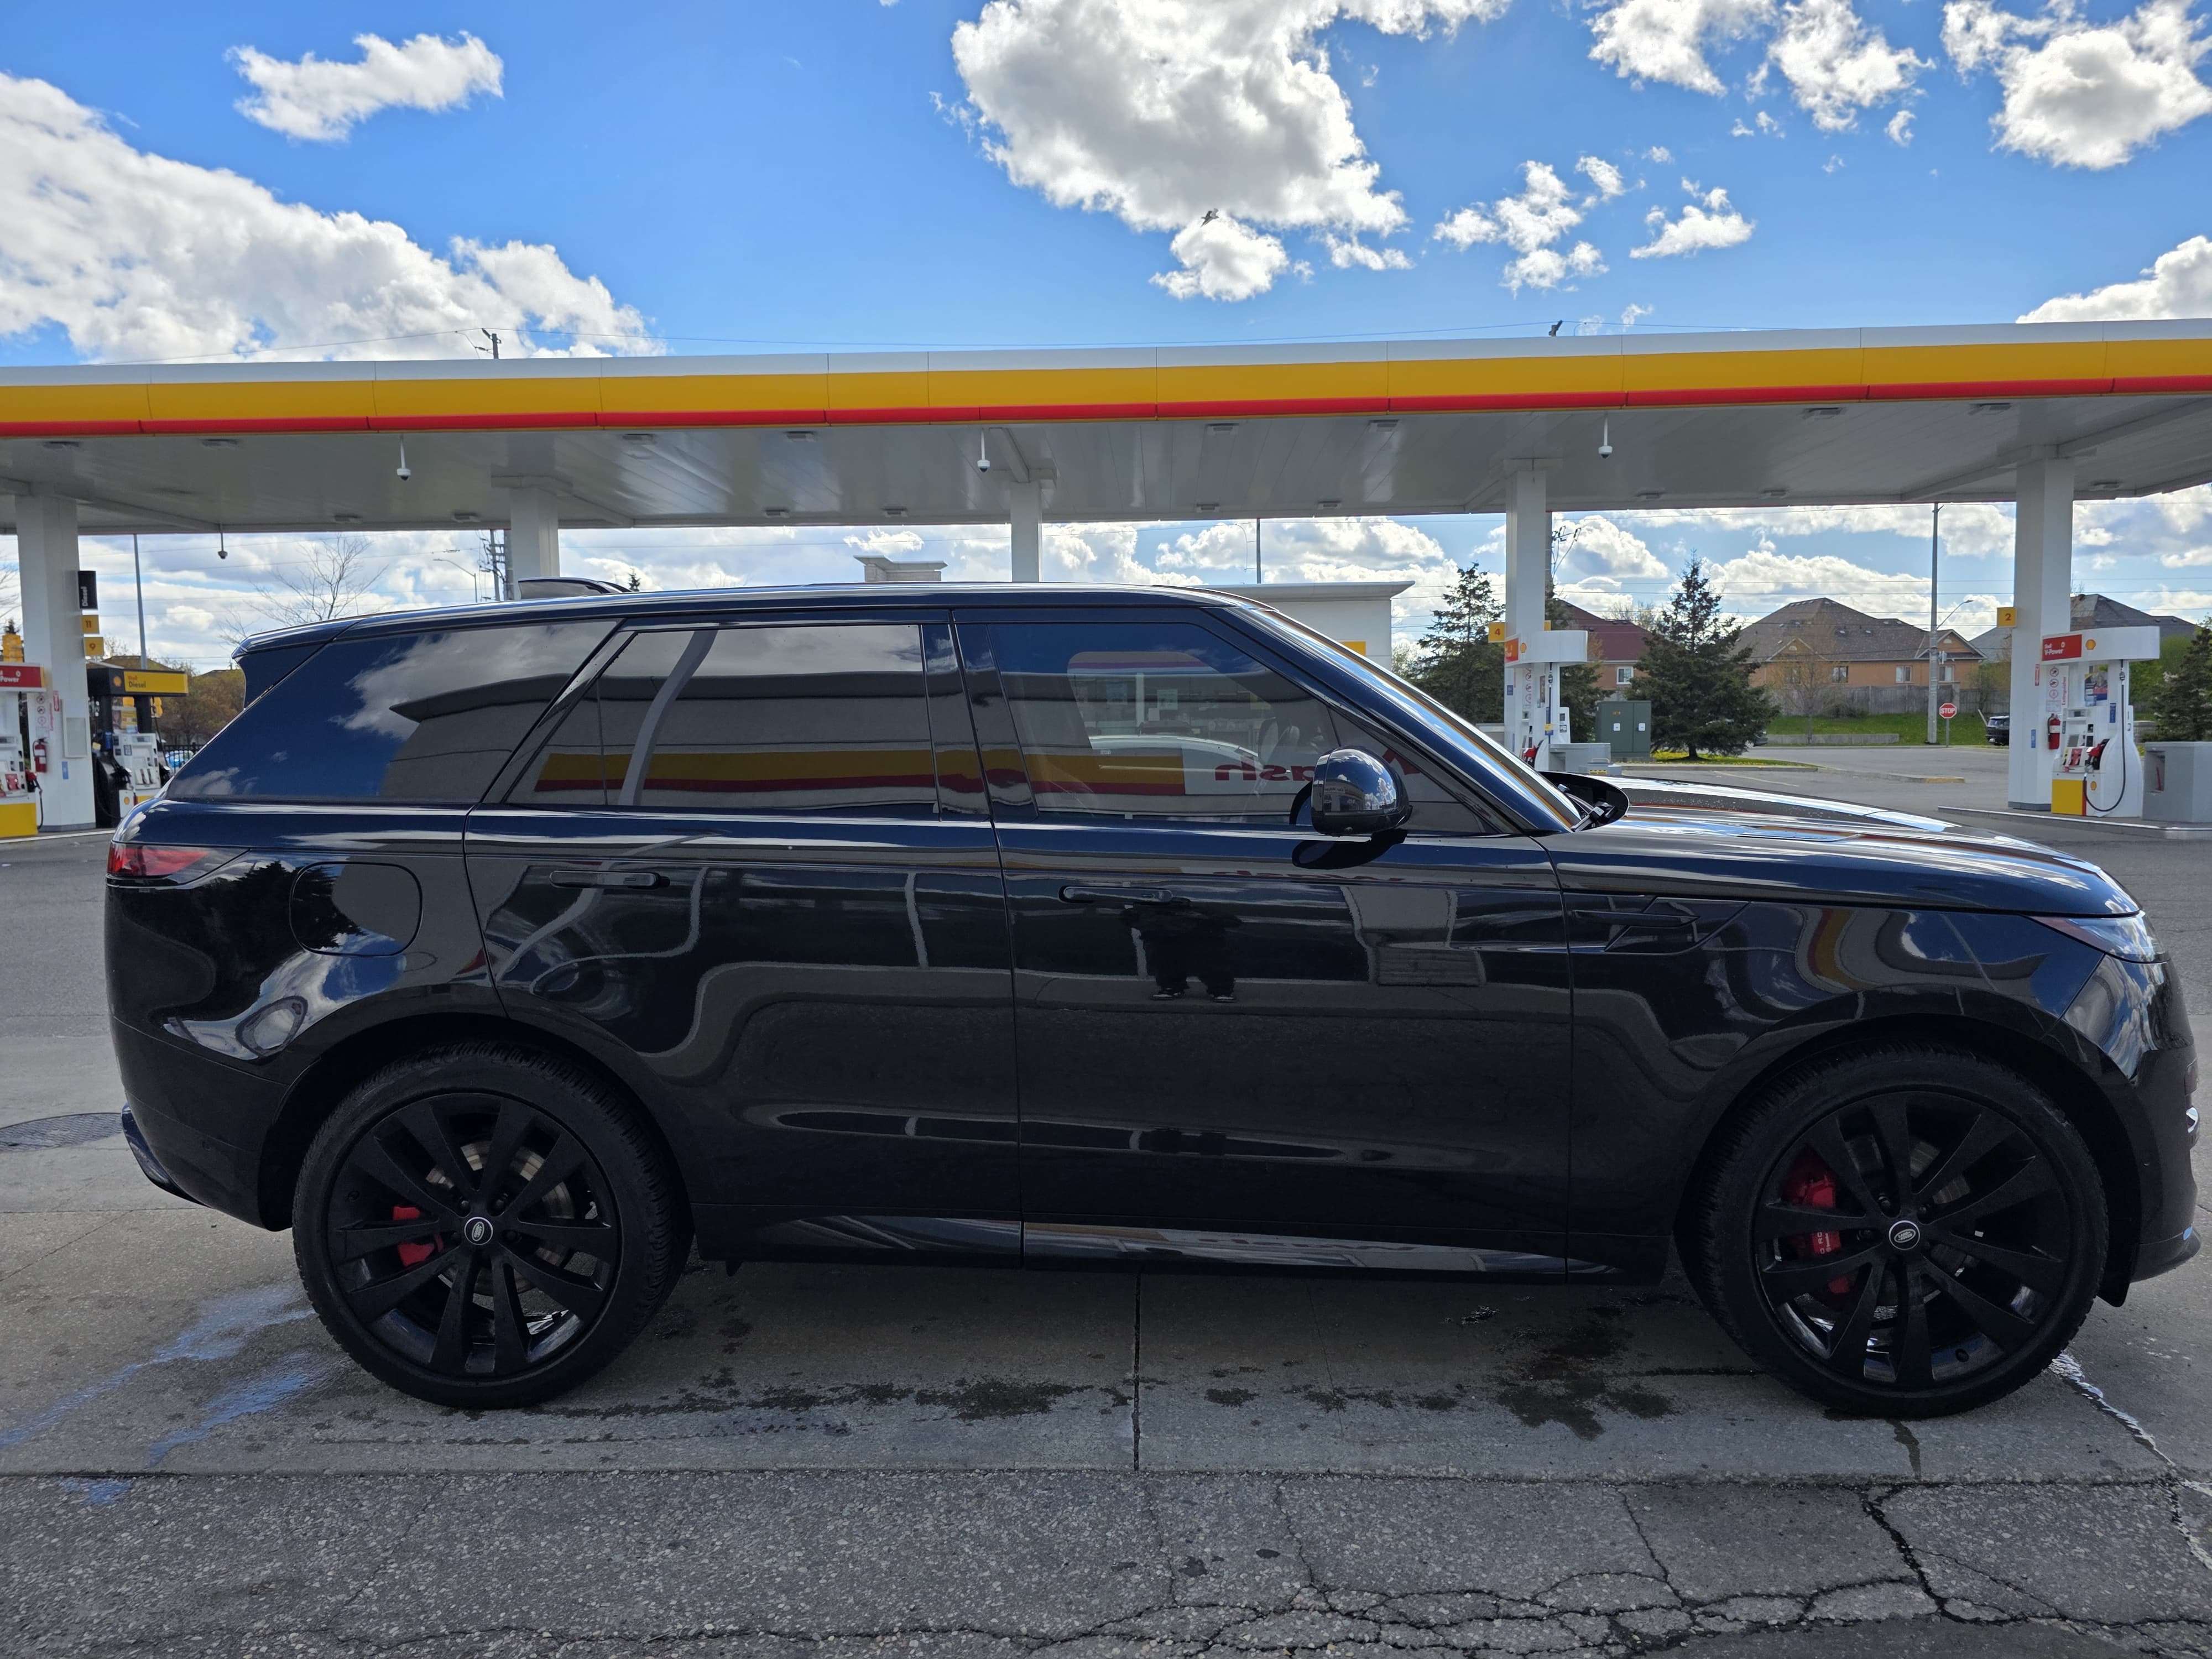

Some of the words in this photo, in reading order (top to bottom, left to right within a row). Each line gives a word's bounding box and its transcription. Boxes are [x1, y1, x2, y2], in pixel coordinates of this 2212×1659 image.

[2005, 613, 2011, 621] 2
[85, 620, 92, 628] 11
[89, 642, 96, 650] 9
